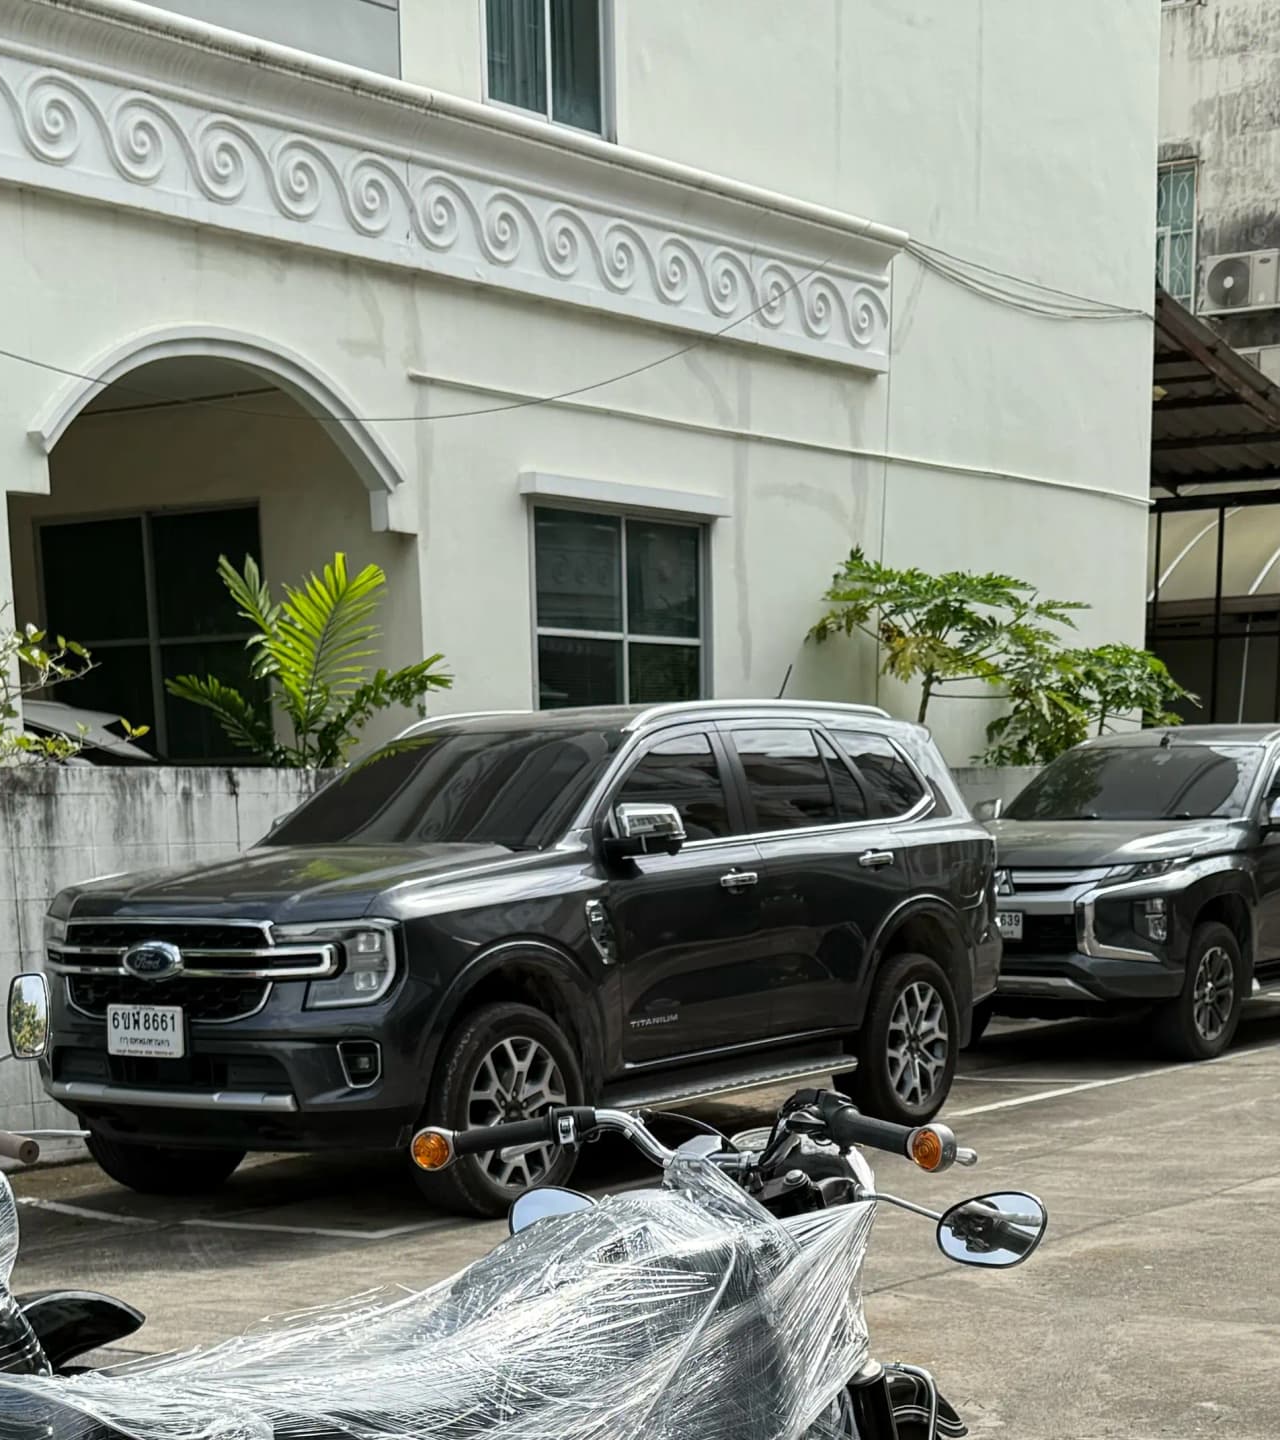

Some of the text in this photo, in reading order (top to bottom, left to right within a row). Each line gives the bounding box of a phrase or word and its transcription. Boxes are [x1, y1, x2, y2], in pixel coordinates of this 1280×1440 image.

[134, 953, 161, 969] Ford
[143, 1013, 175, 1032] 8661
[630, 1013, 678, 1028] TITANIUM
